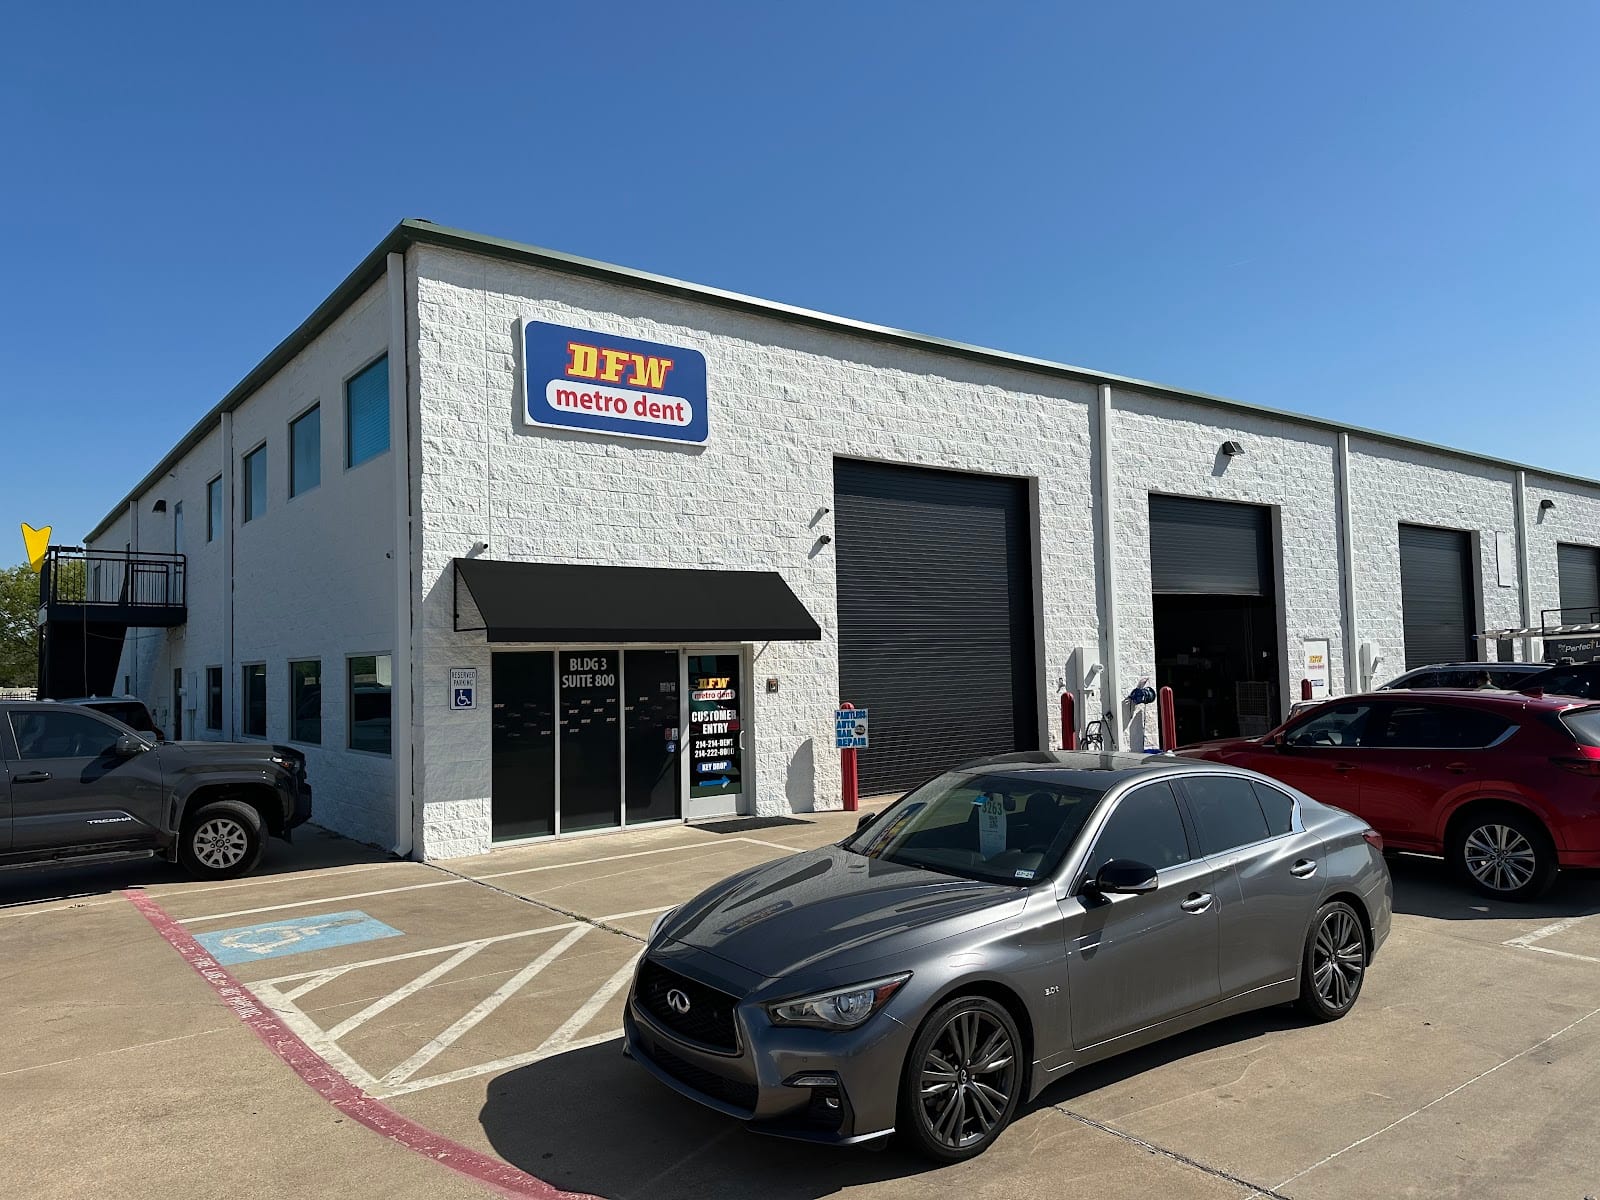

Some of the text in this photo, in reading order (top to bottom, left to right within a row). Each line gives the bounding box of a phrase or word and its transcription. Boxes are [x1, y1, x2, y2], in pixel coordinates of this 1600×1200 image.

[566, 341, 674, 390] DFW
[556, 388, 684, 422] metro dent
[569, 657, 607, 671] BLDG 3
[451, 671, 475, 679] RESERVED
[561, 673, 615, 688] SUITE 800
[697, 677, 730, 689] DFW
[694, 690, 733, 700] metro dent
[691, 709, 737, 722] CUSTOMER
[702, 722, 729, 735] ENTRY
[837, 737, 866, 746] REPAIR
[701, 761, 728, 771] KEY DROP
